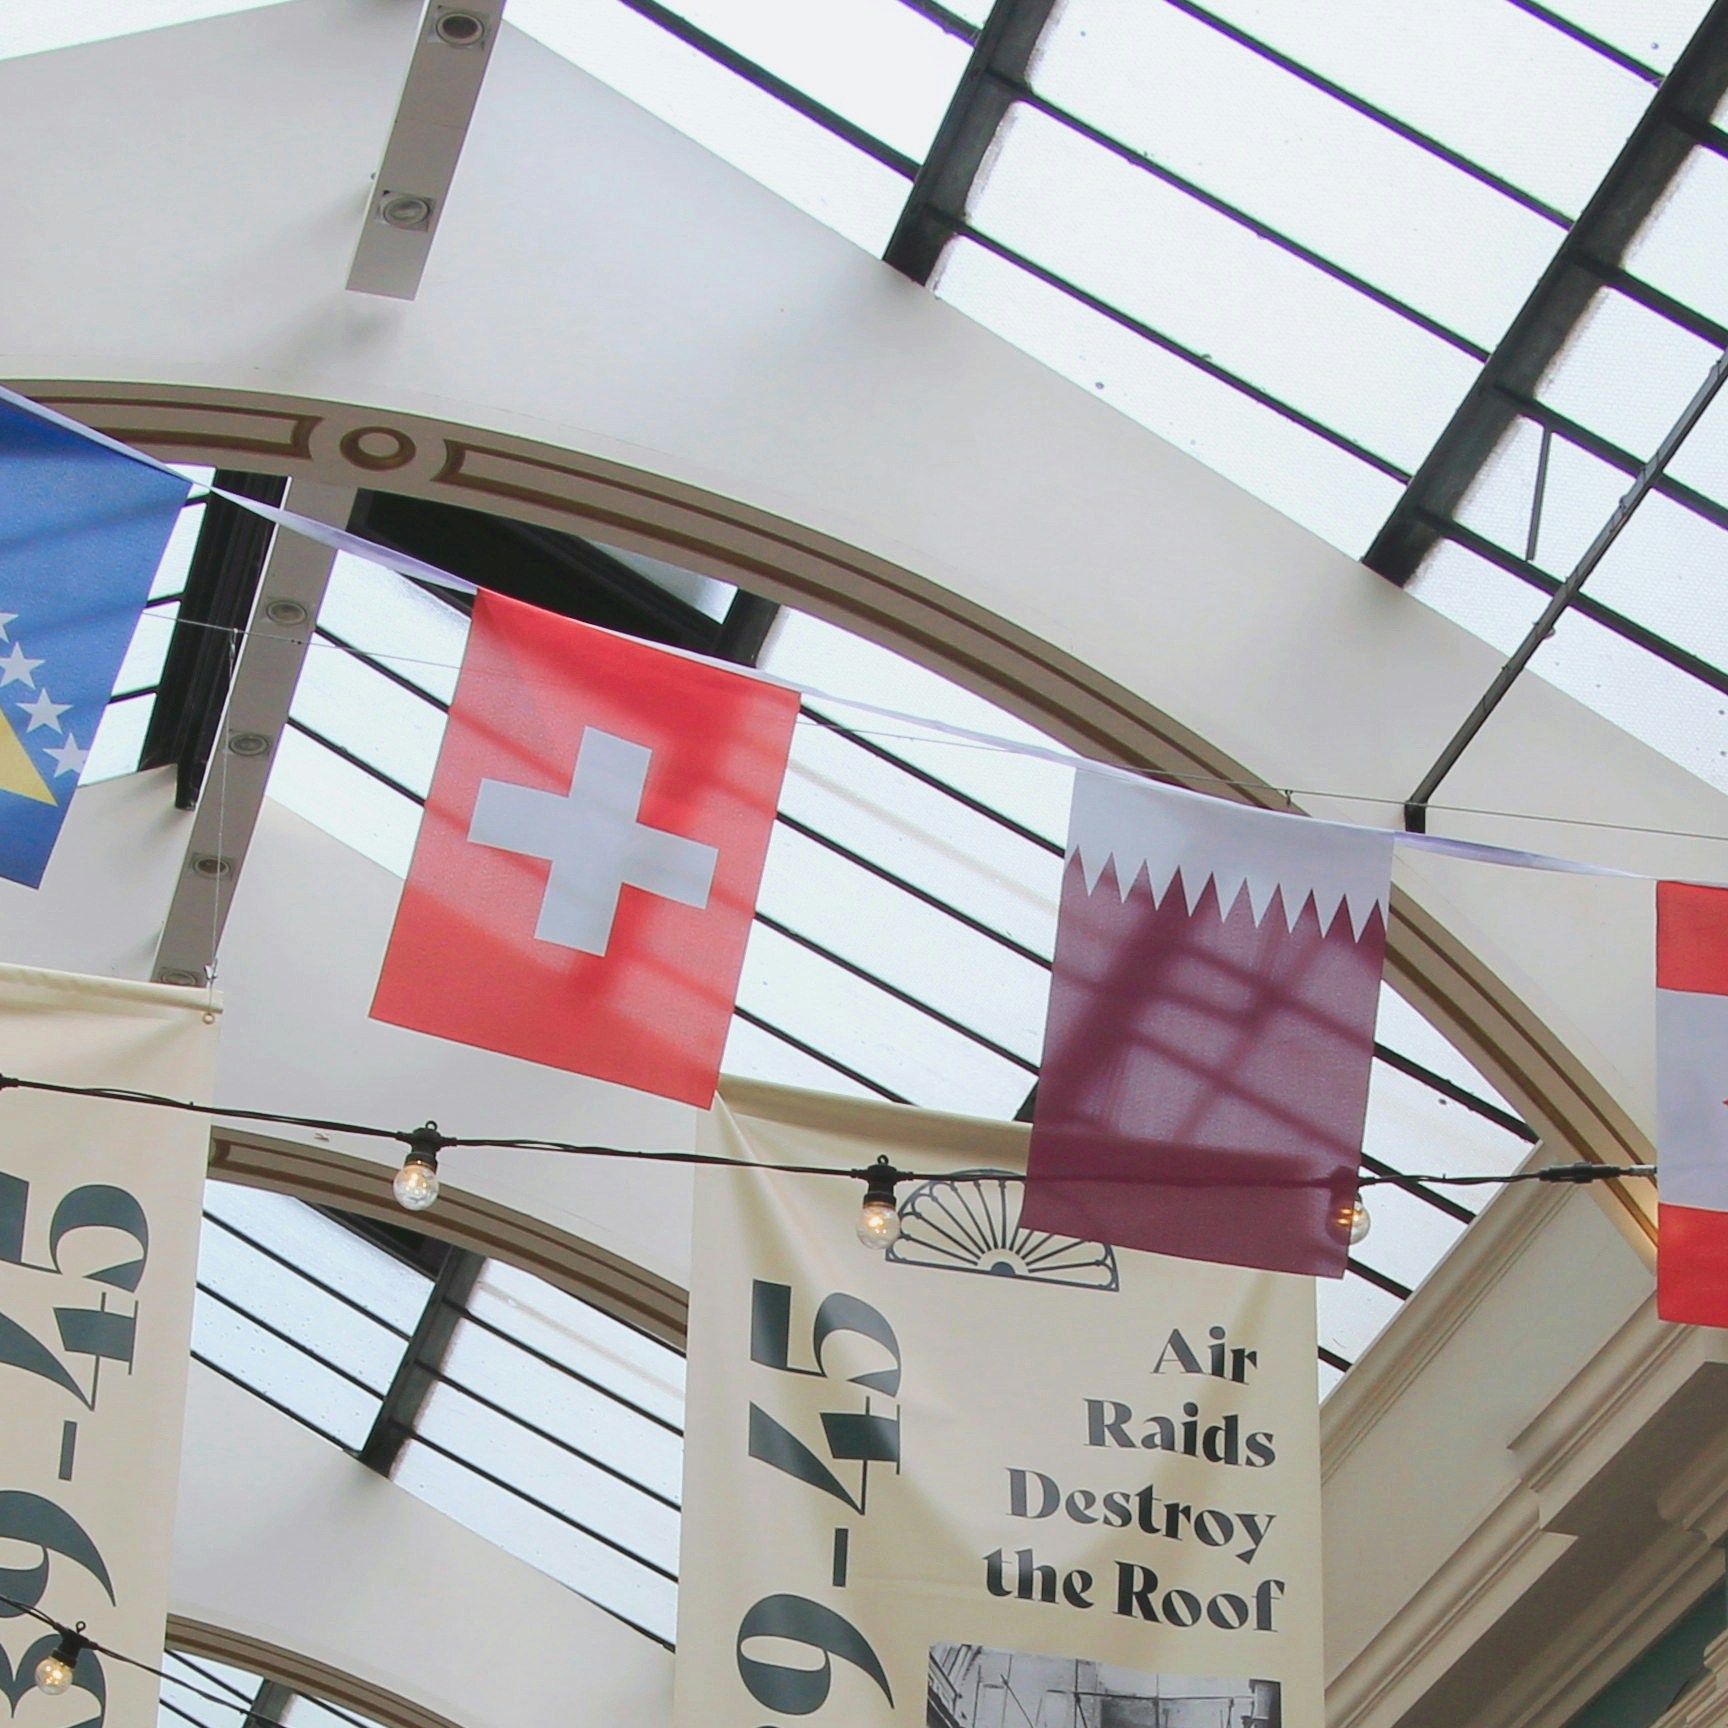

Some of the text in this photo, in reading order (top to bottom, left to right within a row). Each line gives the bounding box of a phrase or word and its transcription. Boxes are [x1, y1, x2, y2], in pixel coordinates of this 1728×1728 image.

[1152, 1326, 1258, 1386] Air
[1082, 1397, 1276, 1468] Raids
[1006, 1467, 1276, 1565] Destroy
[983, 1548, 1285, 1632] the Roof
